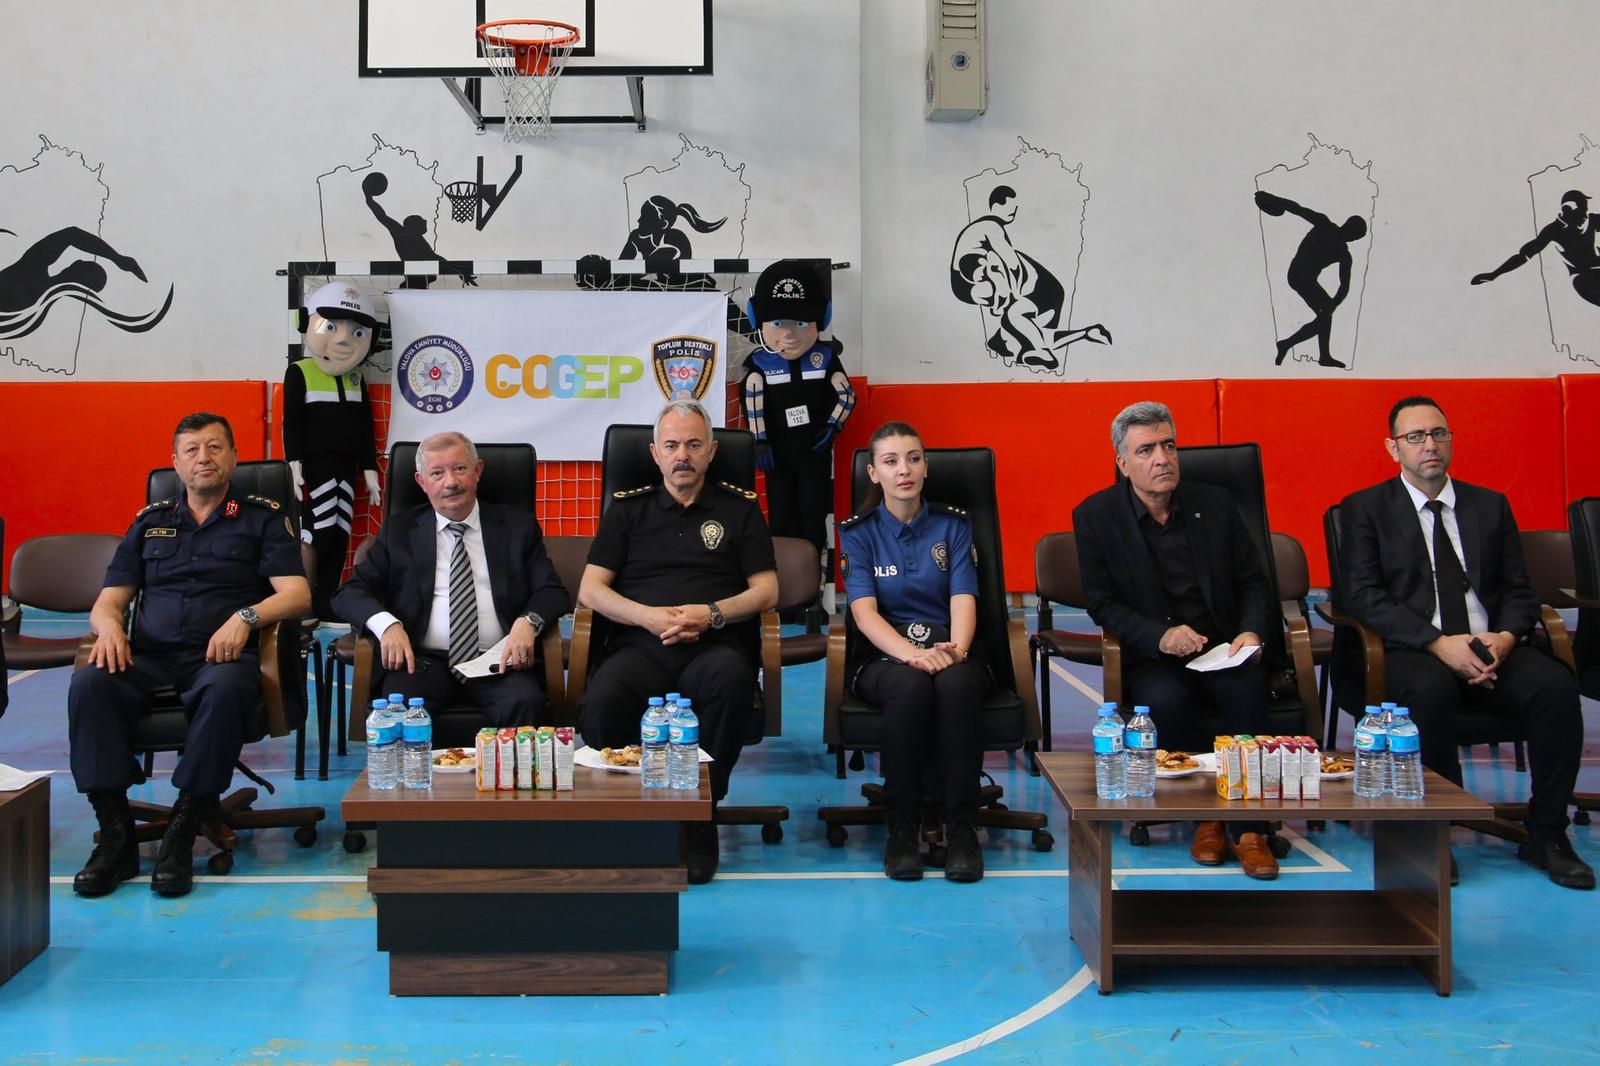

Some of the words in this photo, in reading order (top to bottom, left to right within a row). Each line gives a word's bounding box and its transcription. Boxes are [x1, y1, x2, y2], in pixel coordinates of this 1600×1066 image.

[657, 340, 682, 351] TOPLUM
[684, 340, 713, 351] DESTEKLİ
[400, 348, 416, 370] YALOVA
[414, 338, 442, 350] EMNİYET
[669, 348, 701, 357] POLİS
